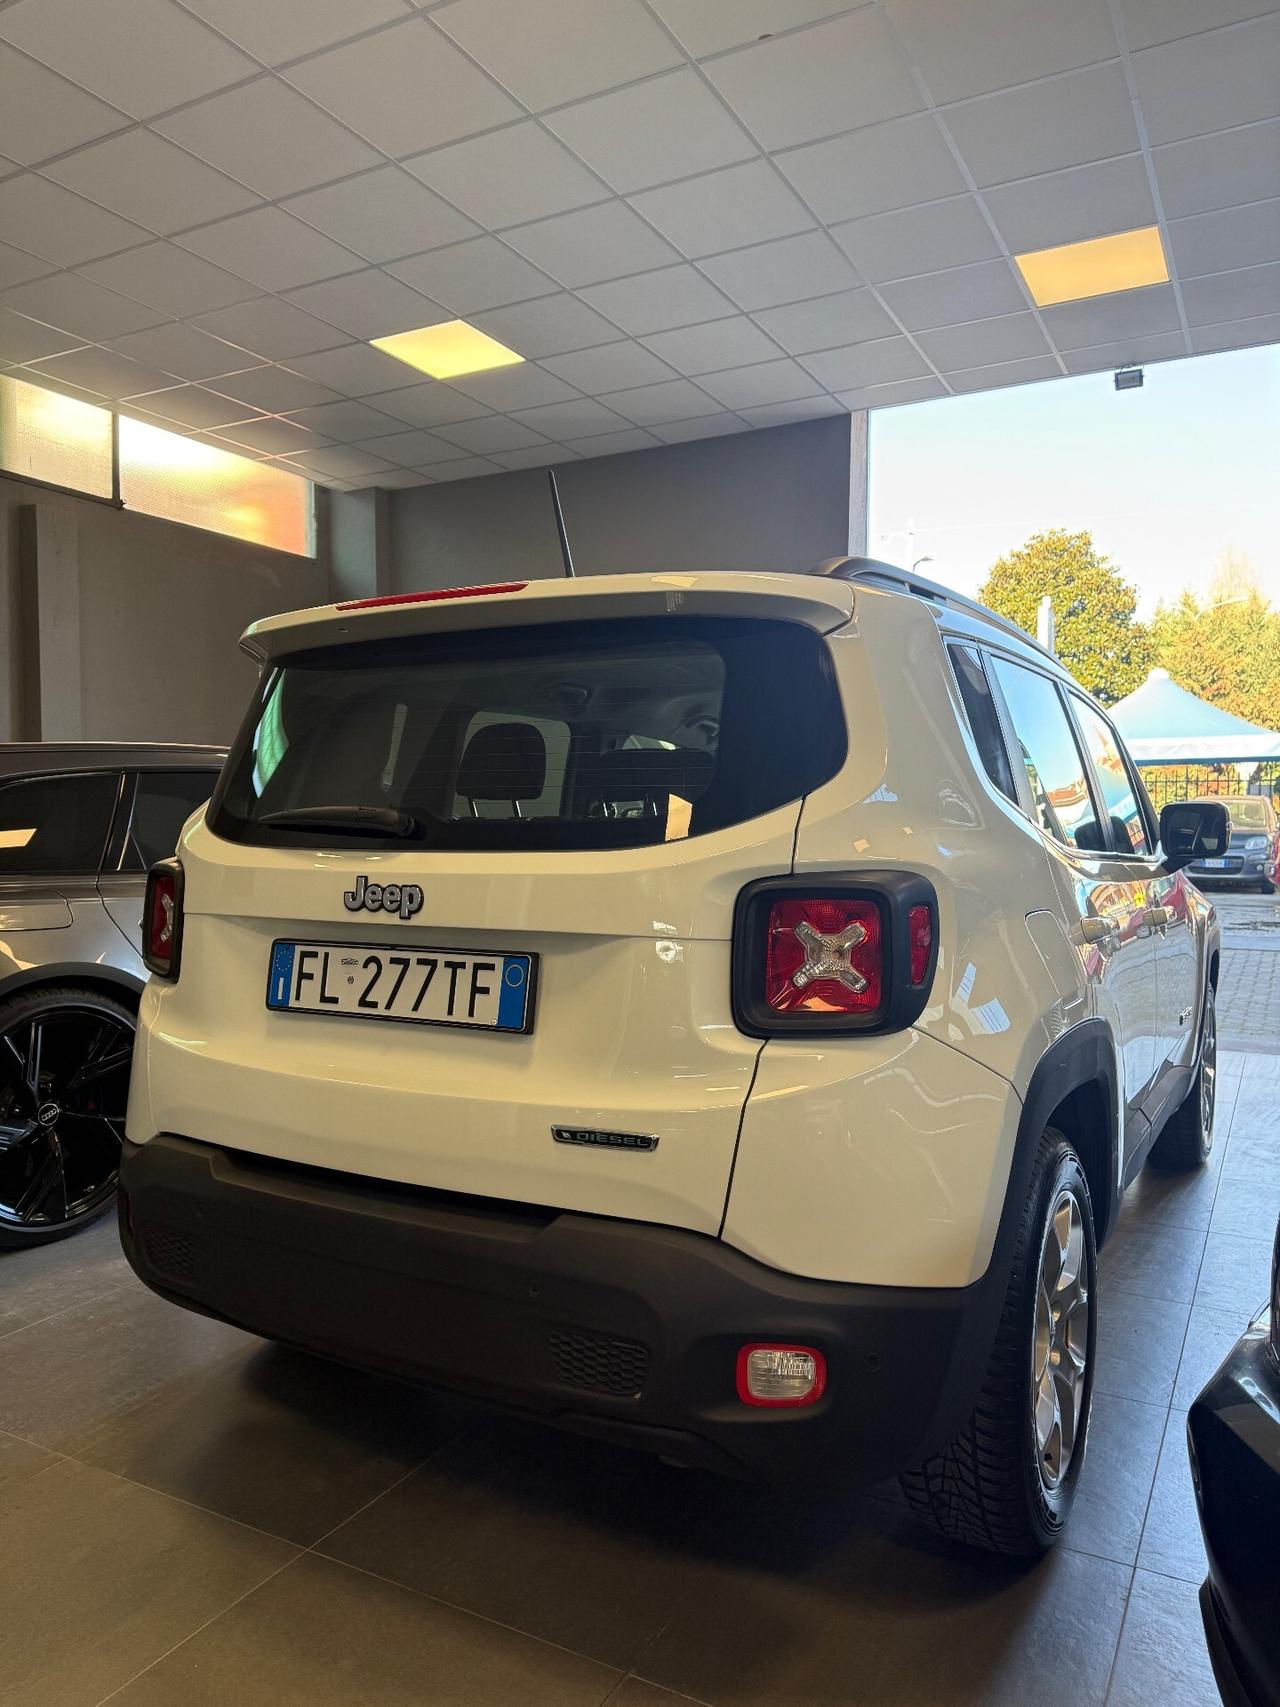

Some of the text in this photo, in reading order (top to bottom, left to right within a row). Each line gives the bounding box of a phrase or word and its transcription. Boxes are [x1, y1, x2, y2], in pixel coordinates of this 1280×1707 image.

[344, 876, 424, 919] Jeep
[277, 978, 284, 1000] I
[295, 951, 496, 1018] FL 277TF
[576, 1132, 649, 1146] DIESEL
